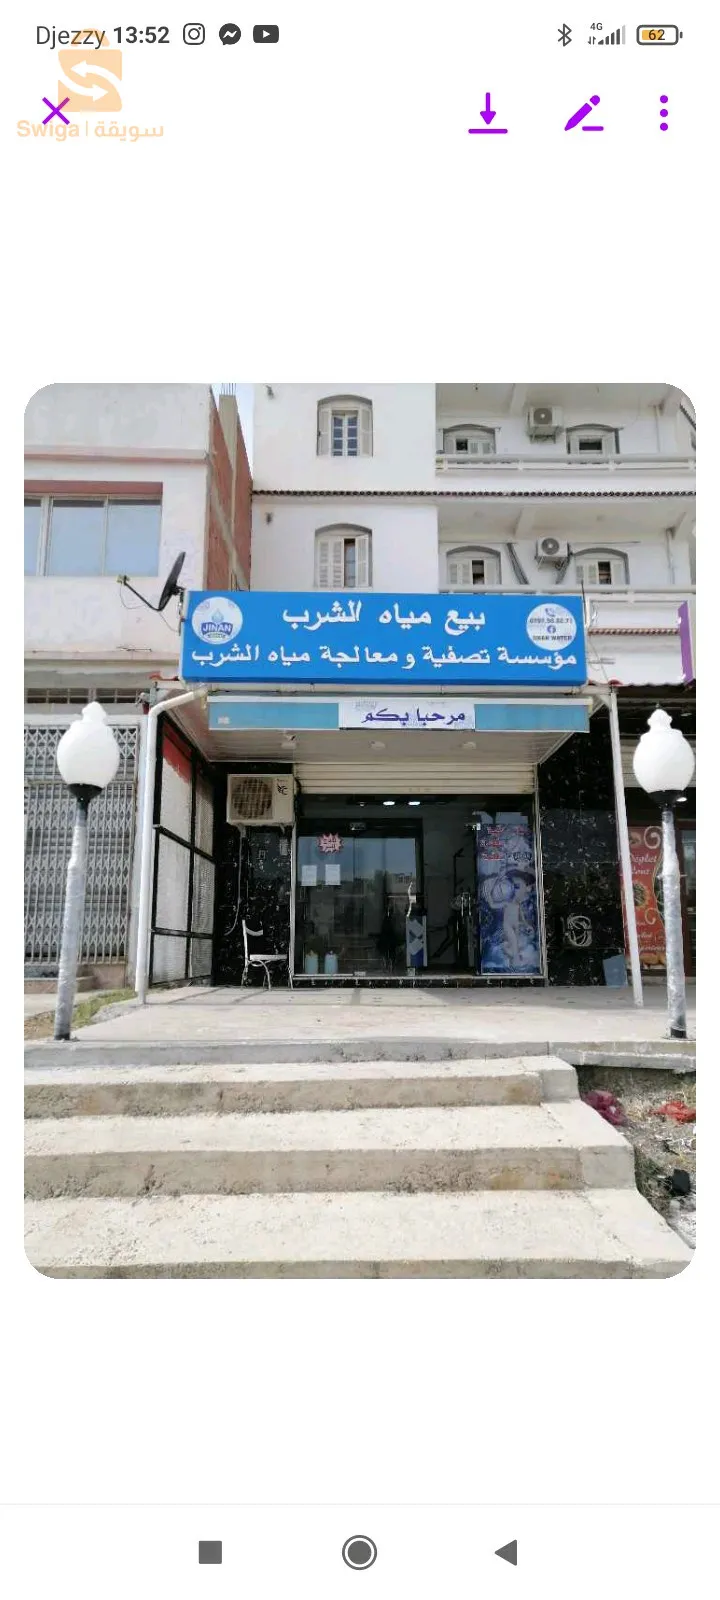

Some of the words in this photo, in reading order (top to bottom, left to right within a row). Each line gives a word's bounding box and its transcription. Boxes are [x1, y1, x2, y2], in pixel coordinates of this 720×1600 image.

[36, 26, 106, 49] Djezzy
[113, 26, 170, 44] 13:52
[590, 22, 603, 31] 4G
[648, 29, 666, 42] 62
[282, 599, 362, 631] الشرب
[378, 602, 432, 629] مياه
[444, 607, 486, 636] بيع
[202, 622, 232, 633] JINAN
[191, 643, 260, 668] الشرب
[267, 644, 311, 668] مياه
[422, 645, 490, 668] تصفية
[496, 646, 577, 670] مؤسسة
[361, 708, 409, 726] بكم
[416, 708, 466, 725] مرحبا
